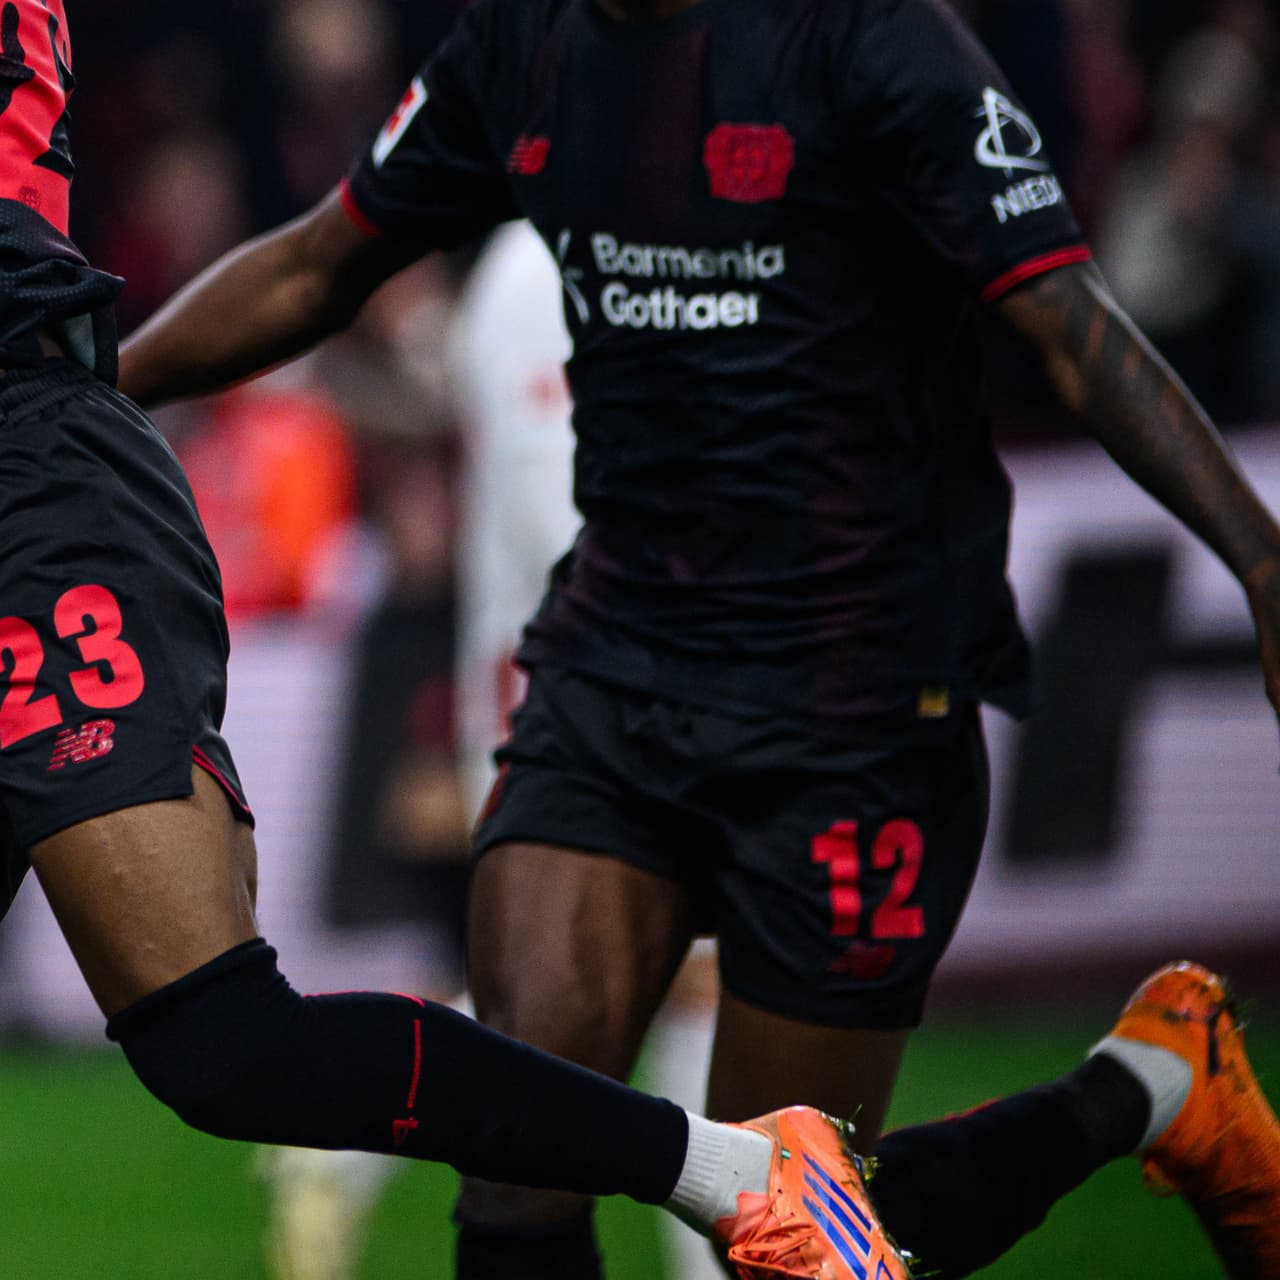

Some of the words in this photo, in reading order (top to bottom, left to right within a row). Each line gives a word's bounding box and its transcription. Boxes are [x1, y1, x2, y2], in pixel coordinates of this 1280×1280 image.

[991, 174, 1064, 224] NIED
[590, 232, 784, 281] Barmenia
[600, 281, 760, 331] Gothaer
[810, 818, 925, 939] 12
